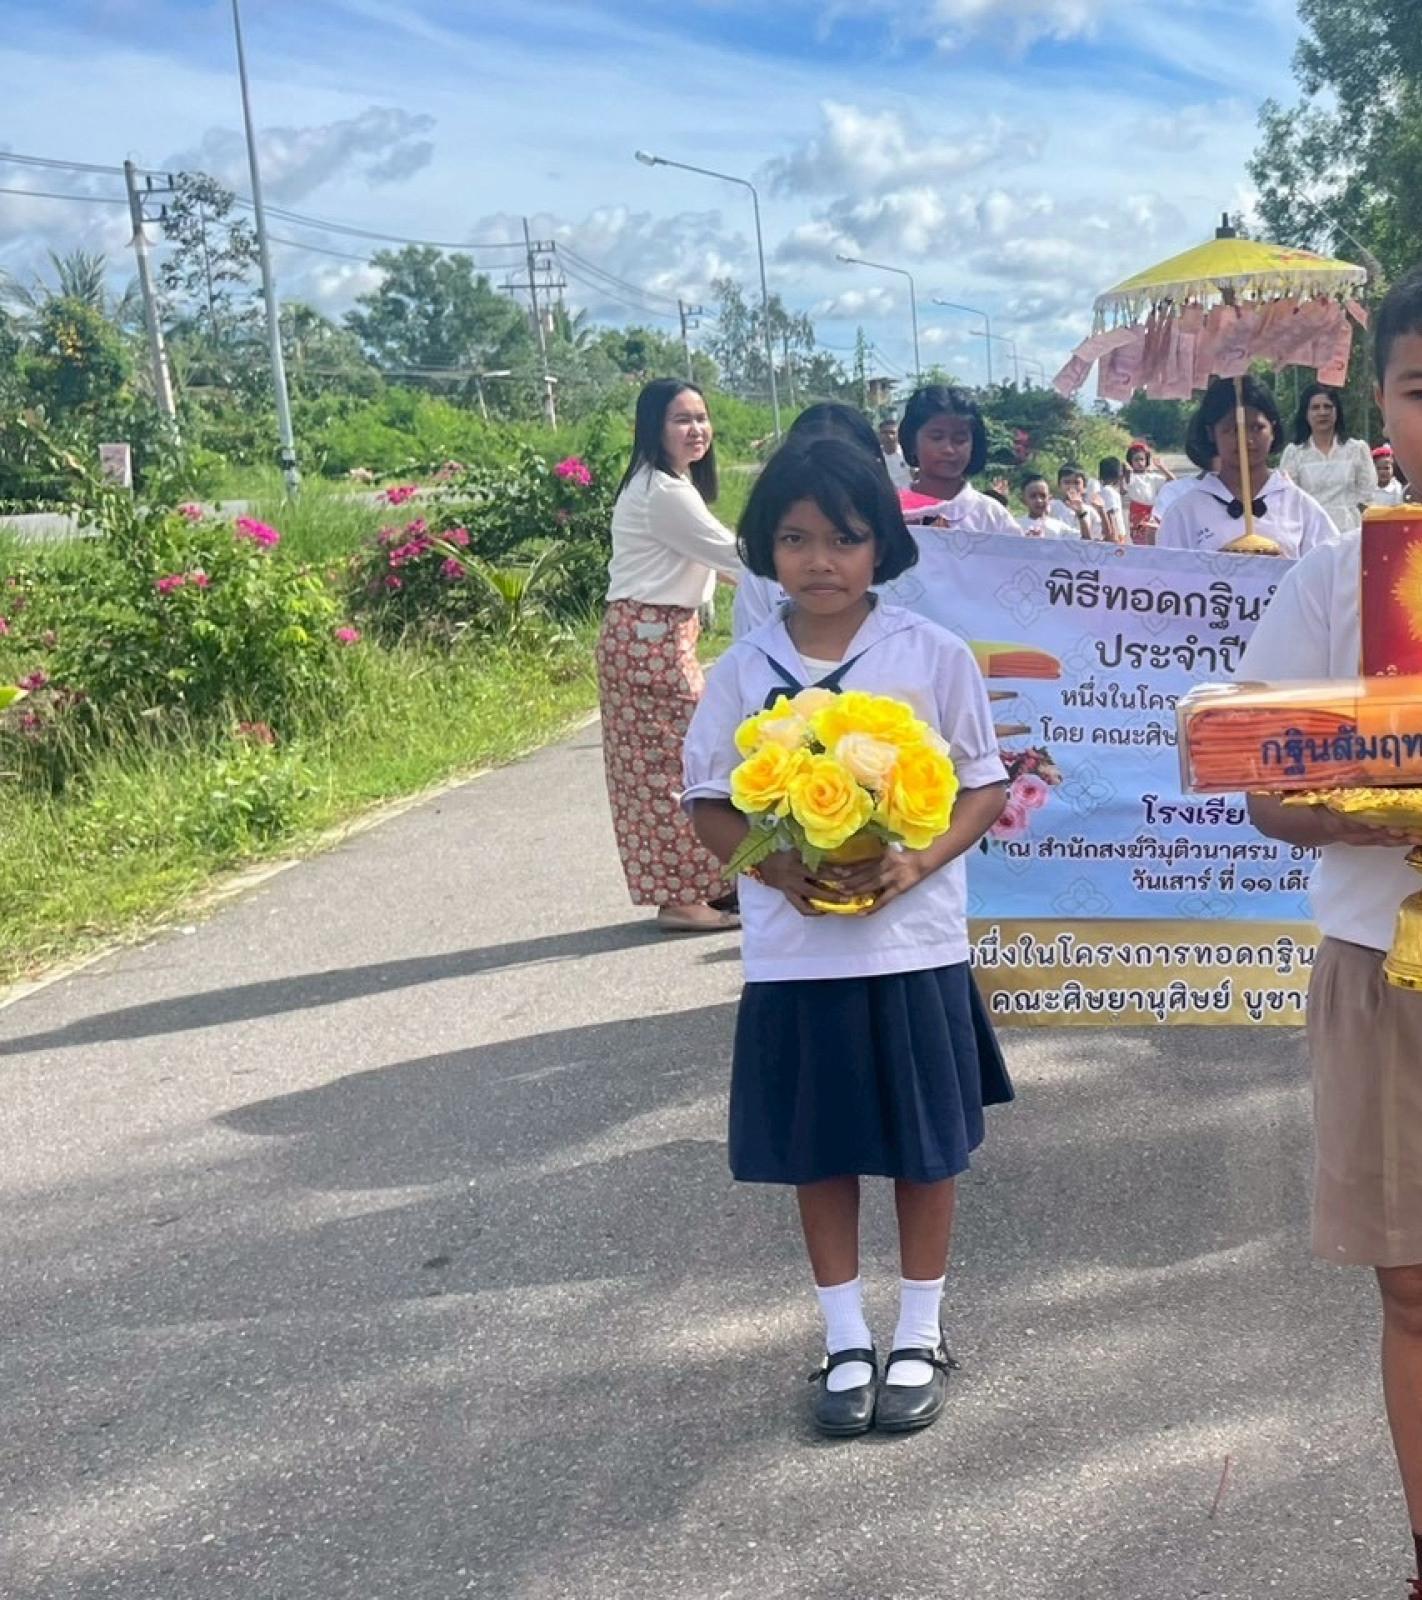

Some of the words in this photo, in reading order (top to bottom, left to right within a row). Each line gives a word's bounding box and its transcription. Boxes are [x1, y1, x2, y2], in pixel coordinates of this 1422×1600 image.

[1040, 716, 1084, 743] โดย
[1008, 842, 1030, 857] ณ
[1133, 867, 1212, 890] วันเสาร์
[1218, 863, 1234, 890] ที่
[1241, 878, 1272, 892] ๑๑
[991, 978, 1232, 1021] คณะศิษยานุศิษย์
[1243, 990, 1308, 1020] บูชา
